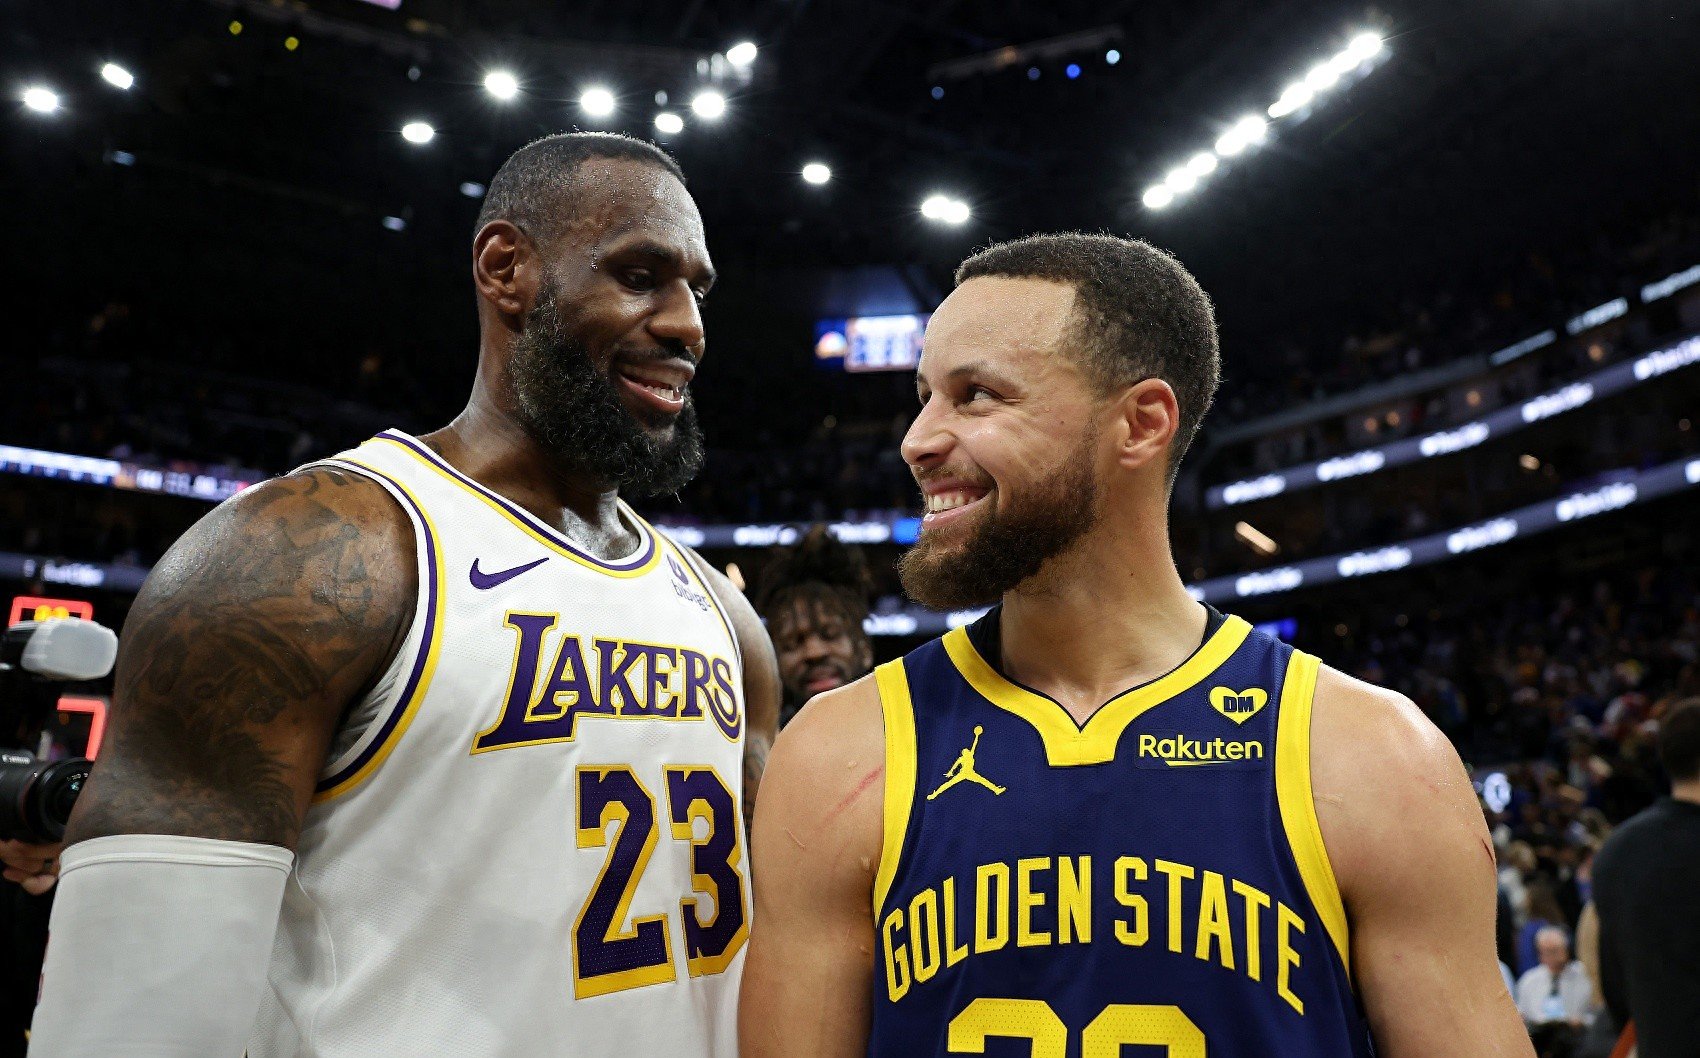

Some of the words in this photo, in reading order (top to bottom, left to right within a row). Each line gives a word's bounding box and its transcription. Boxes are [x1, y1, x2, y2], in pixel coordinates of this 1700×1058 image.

[470, 610, 742, 755] LAKERS
[1139, 734, 1263, 759] Rakuten
[1223, 695, 1255, 713] DM
[571, 764, 749, 999] 23
[882, 855, 1092, 1003] GOLDEN
[1114, 855, 1306, 1016] STATE
